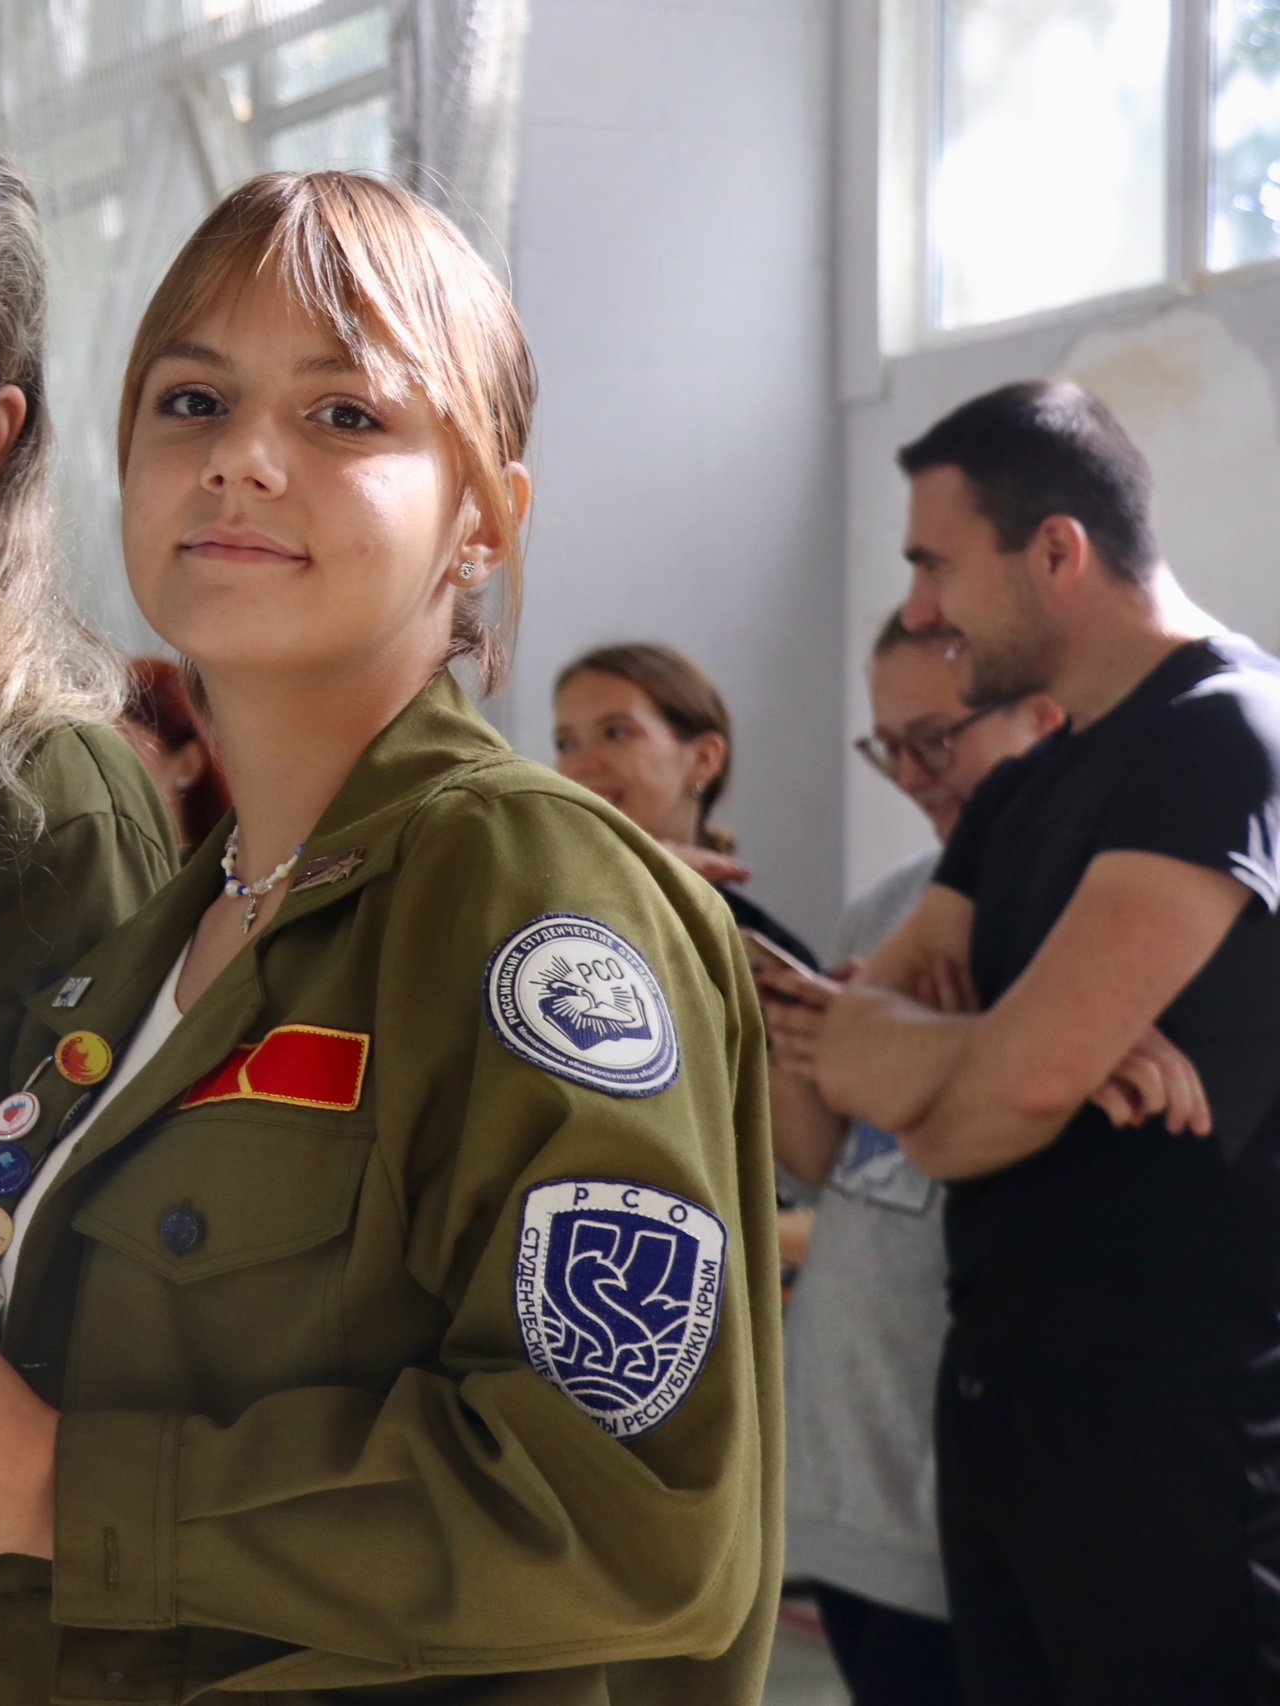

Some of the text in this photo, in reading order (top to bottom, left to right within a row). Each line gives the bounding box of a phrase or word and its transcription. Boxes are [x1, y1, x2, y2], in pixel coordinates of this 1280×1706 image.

[499, 950, 524, 1026] РОССИЙСКИЕ
[520, 925, 614, 951] СТУДЕНЧЕСКИЕ
[575, 957, 624, 984] РСО
[517, 1227, 554, 1377] СТУДЕНЧЕСКИЕ
[622, 1321, 709, 1433] РЕСПУБЛИКИ
[694, 1259, 718, 1319] КРЫМ
